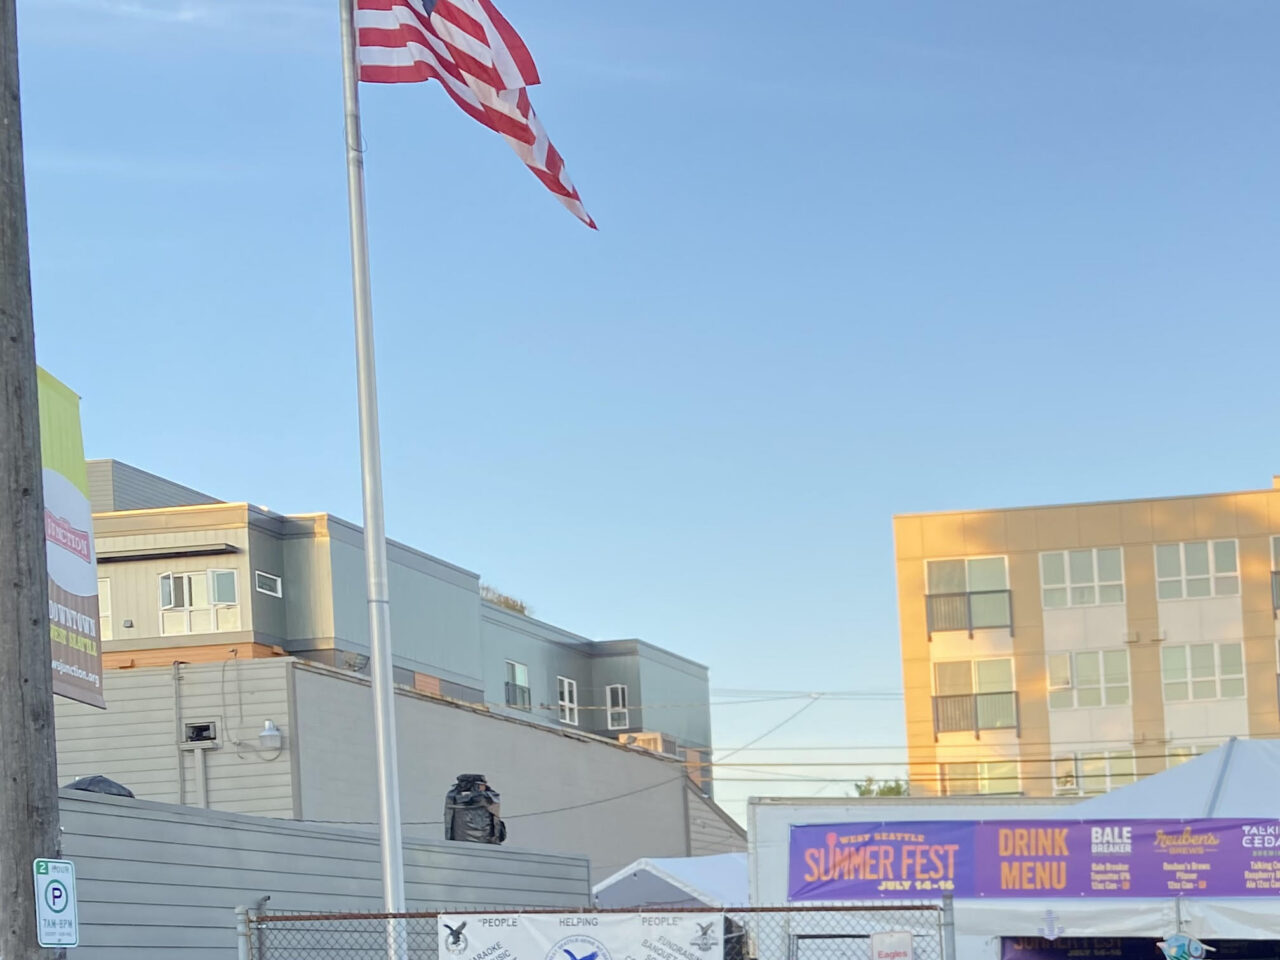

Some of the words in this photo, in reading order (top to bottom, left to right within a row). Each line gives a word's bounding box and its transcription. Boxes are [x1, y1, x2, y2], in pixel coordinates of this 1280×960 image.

[49, 600, 96, 637] DOWNTOWN
[839, 833, 870, 844] WEST
[874, 832, 925, 843] SEATTLE
[1091, 826, 1132, 843] BALE
[998, 827, 1070, 857] DRINK
[1091, 844, 1132, 853] BREAKER
[39, 862, 46, 873] 2
[52, 865, 69, 873] HOUR
[804, 843, 895, 882] SUMMER
[901, 843, 959, 881] FEST
[1000, 861, 1067, 890] MENU
[877, 880, 912, 891] JULY
[52, 887, 62, 906] P
[559, 917, 599, 928] HELPING
[878, 950, 908, 960] Eagles
